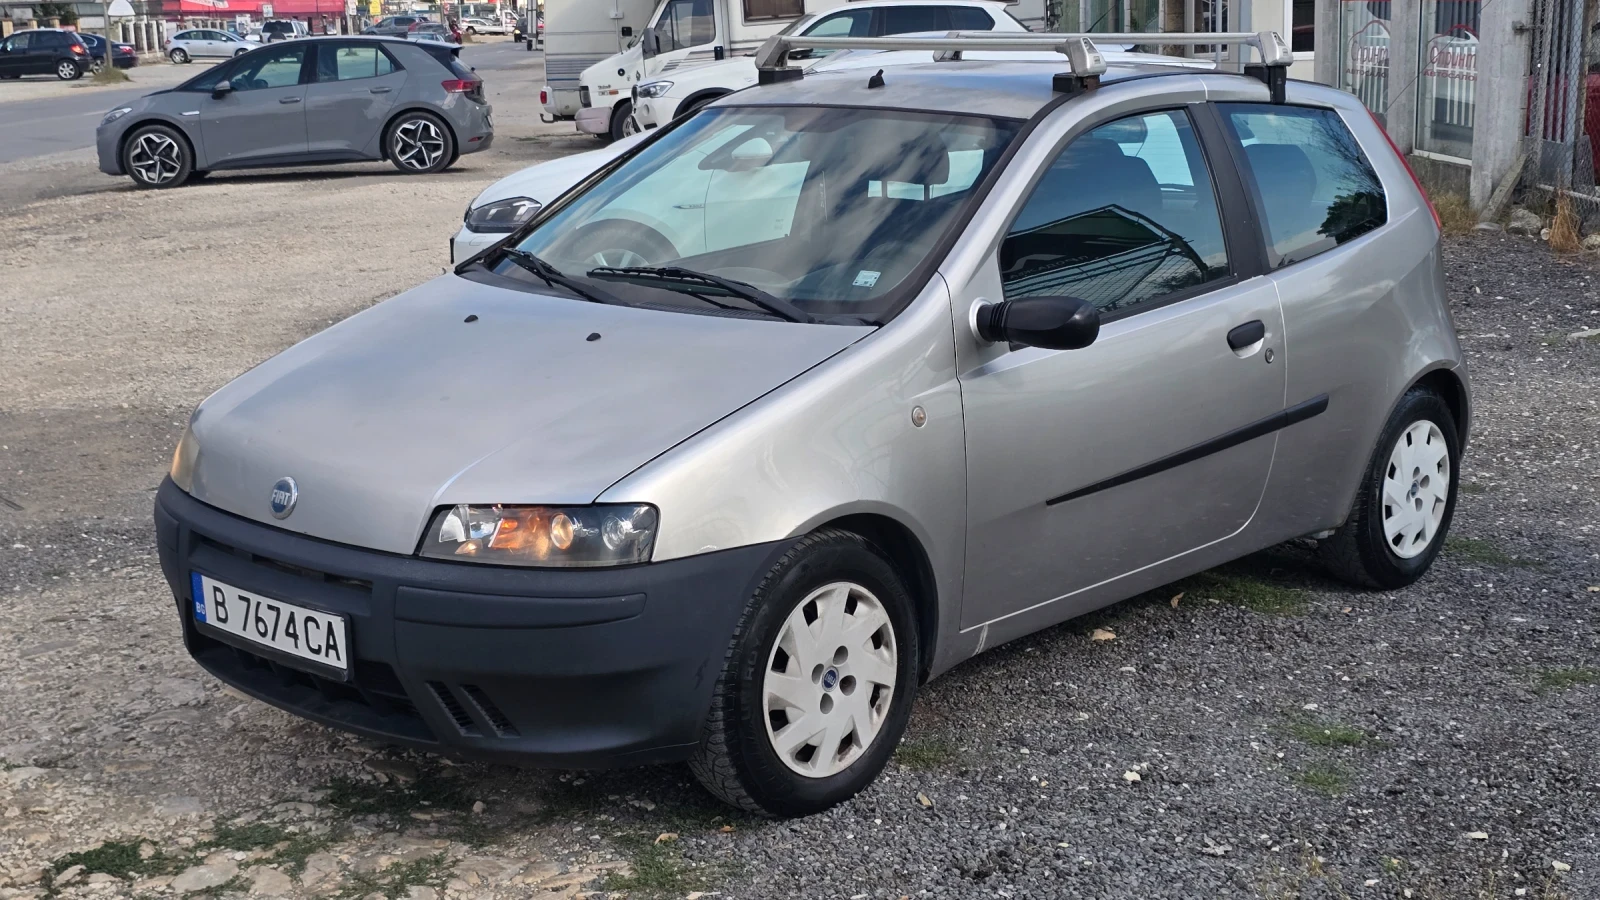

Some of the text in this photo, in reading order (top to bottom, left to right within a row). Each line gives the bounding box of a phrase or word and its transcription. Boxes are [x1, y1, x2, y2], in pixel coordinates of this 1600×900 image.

[1346, 69, 1388, 78] АВТОСАЛО
[271, 489, 291, 505] FIAT
[196, 602, 206, 614] BG
[213, 586, 228, 623] B
